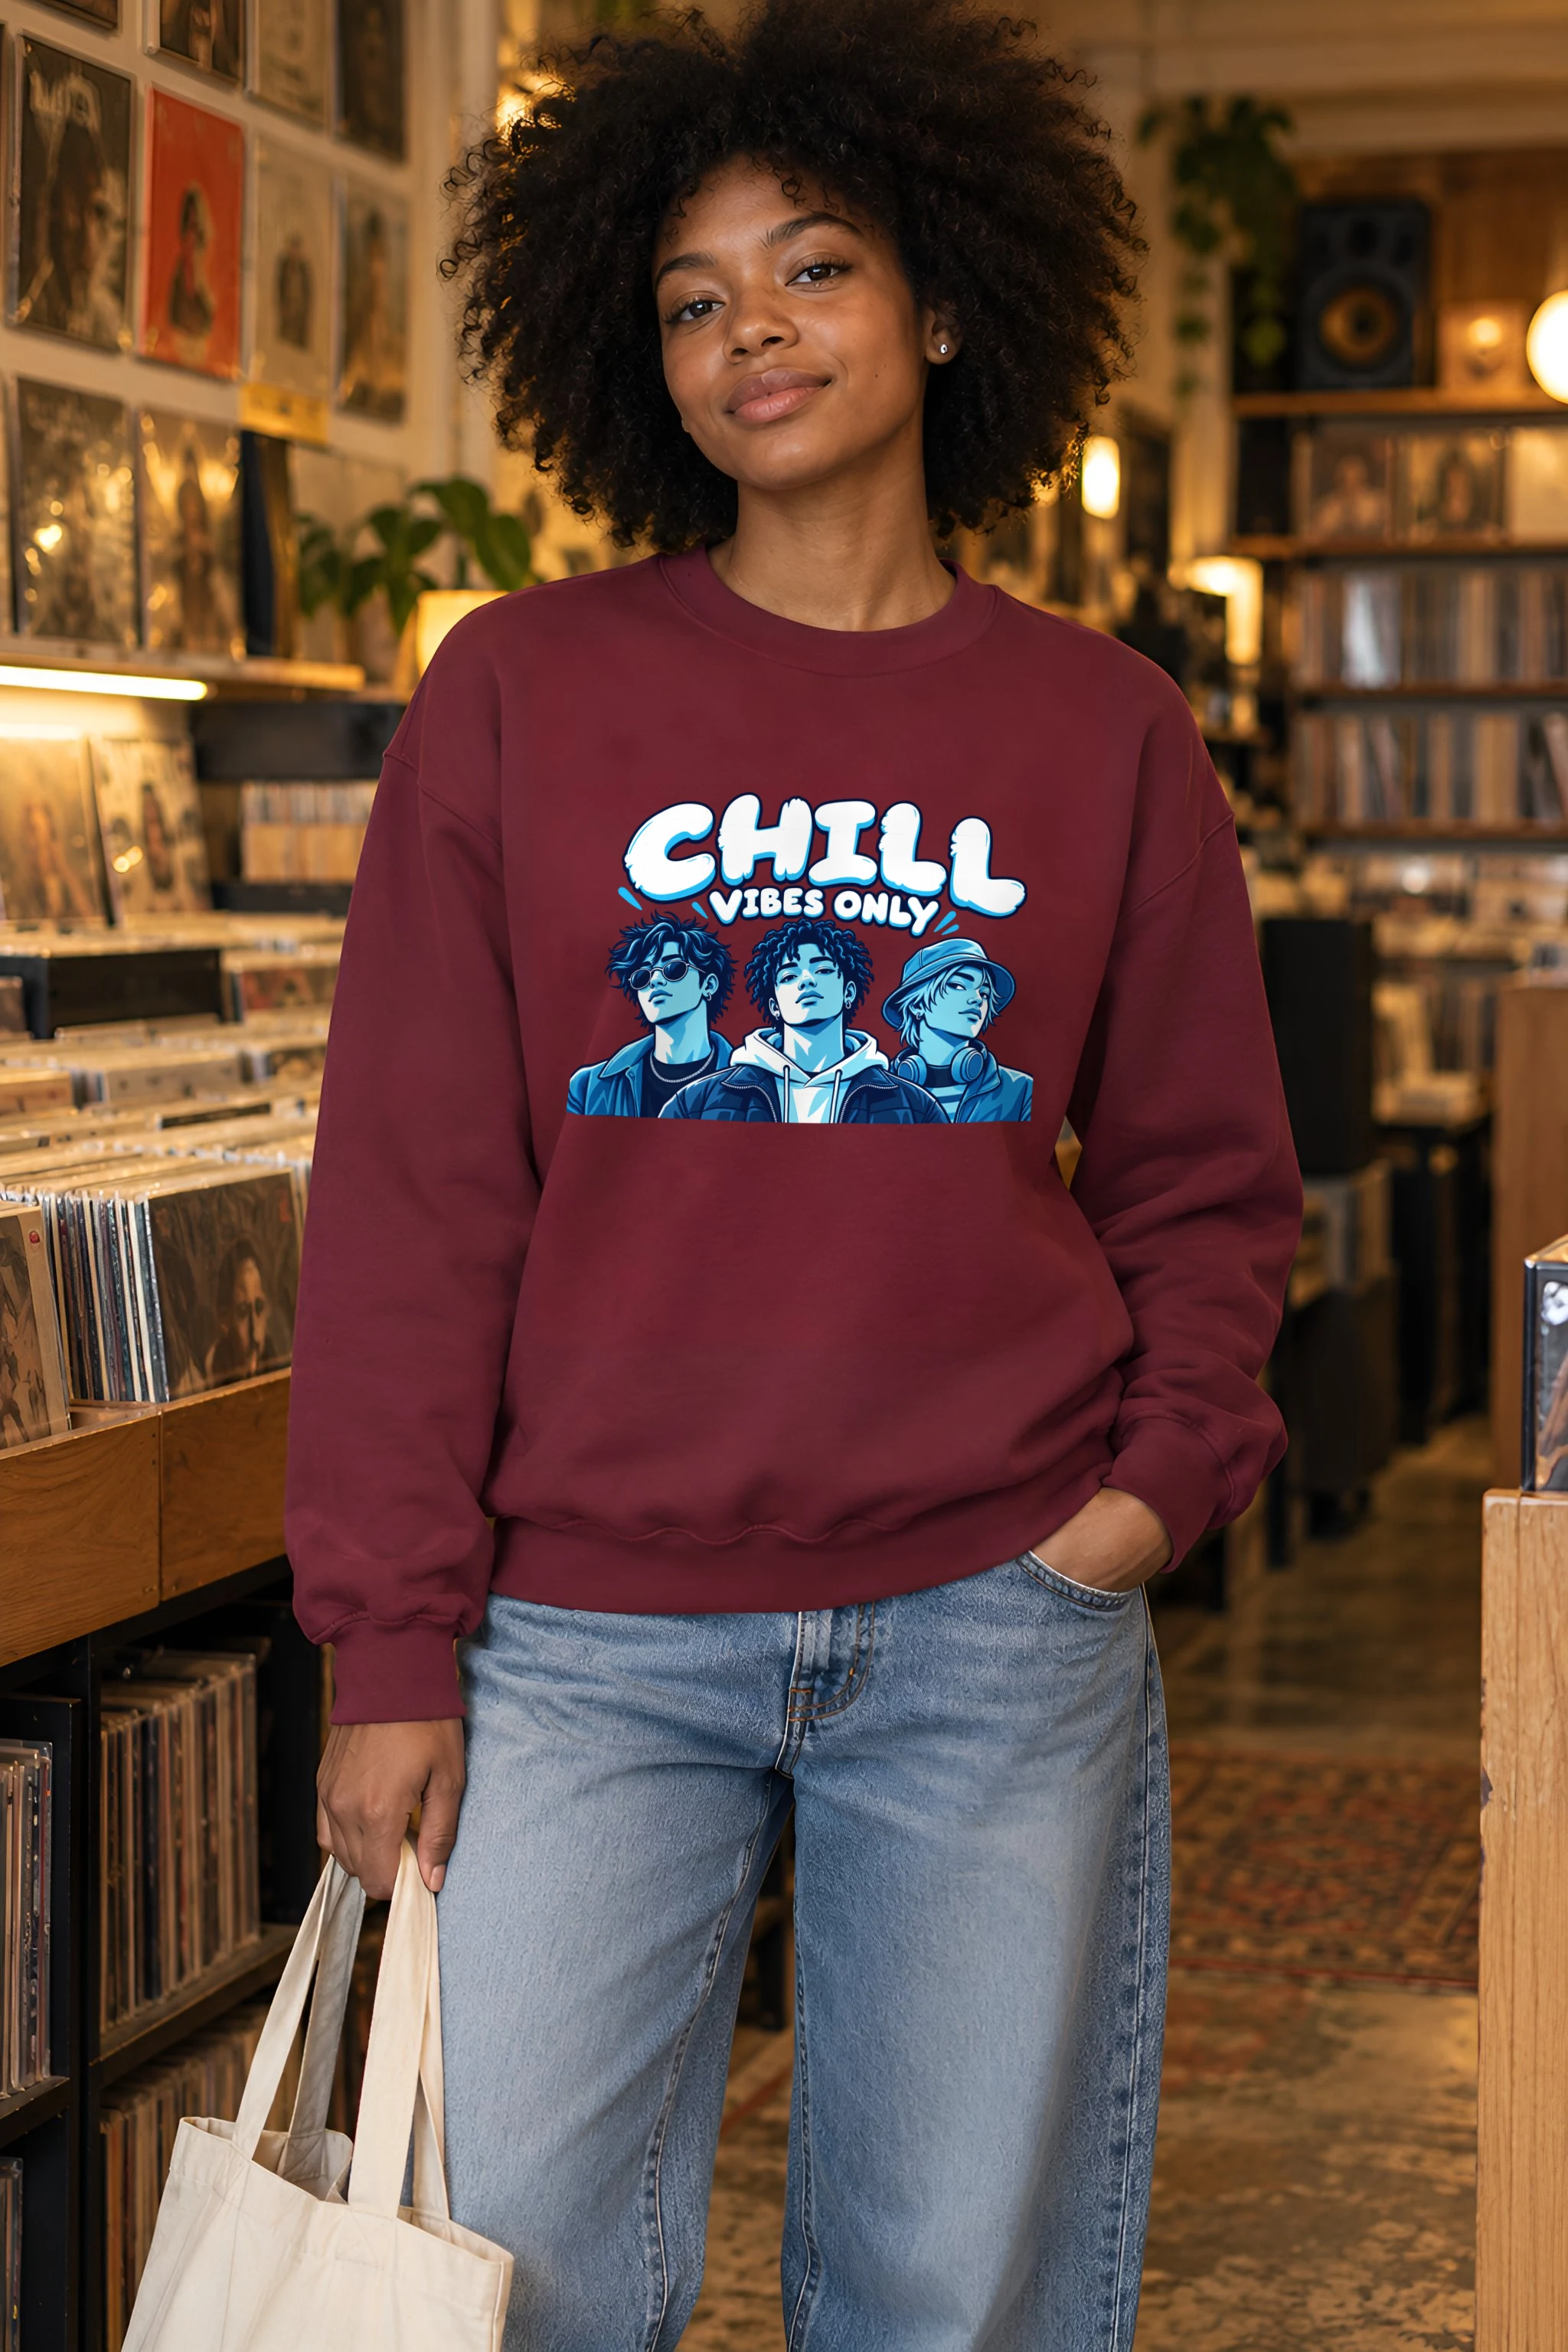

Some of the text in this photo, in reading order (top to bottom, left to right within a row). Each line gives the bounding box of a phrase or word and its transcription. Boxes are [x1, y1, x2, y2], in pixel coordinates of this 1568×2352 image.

[624, 794, 1027, 917] CHILL
[708, 887, 939, 936] VIBES ONLY
